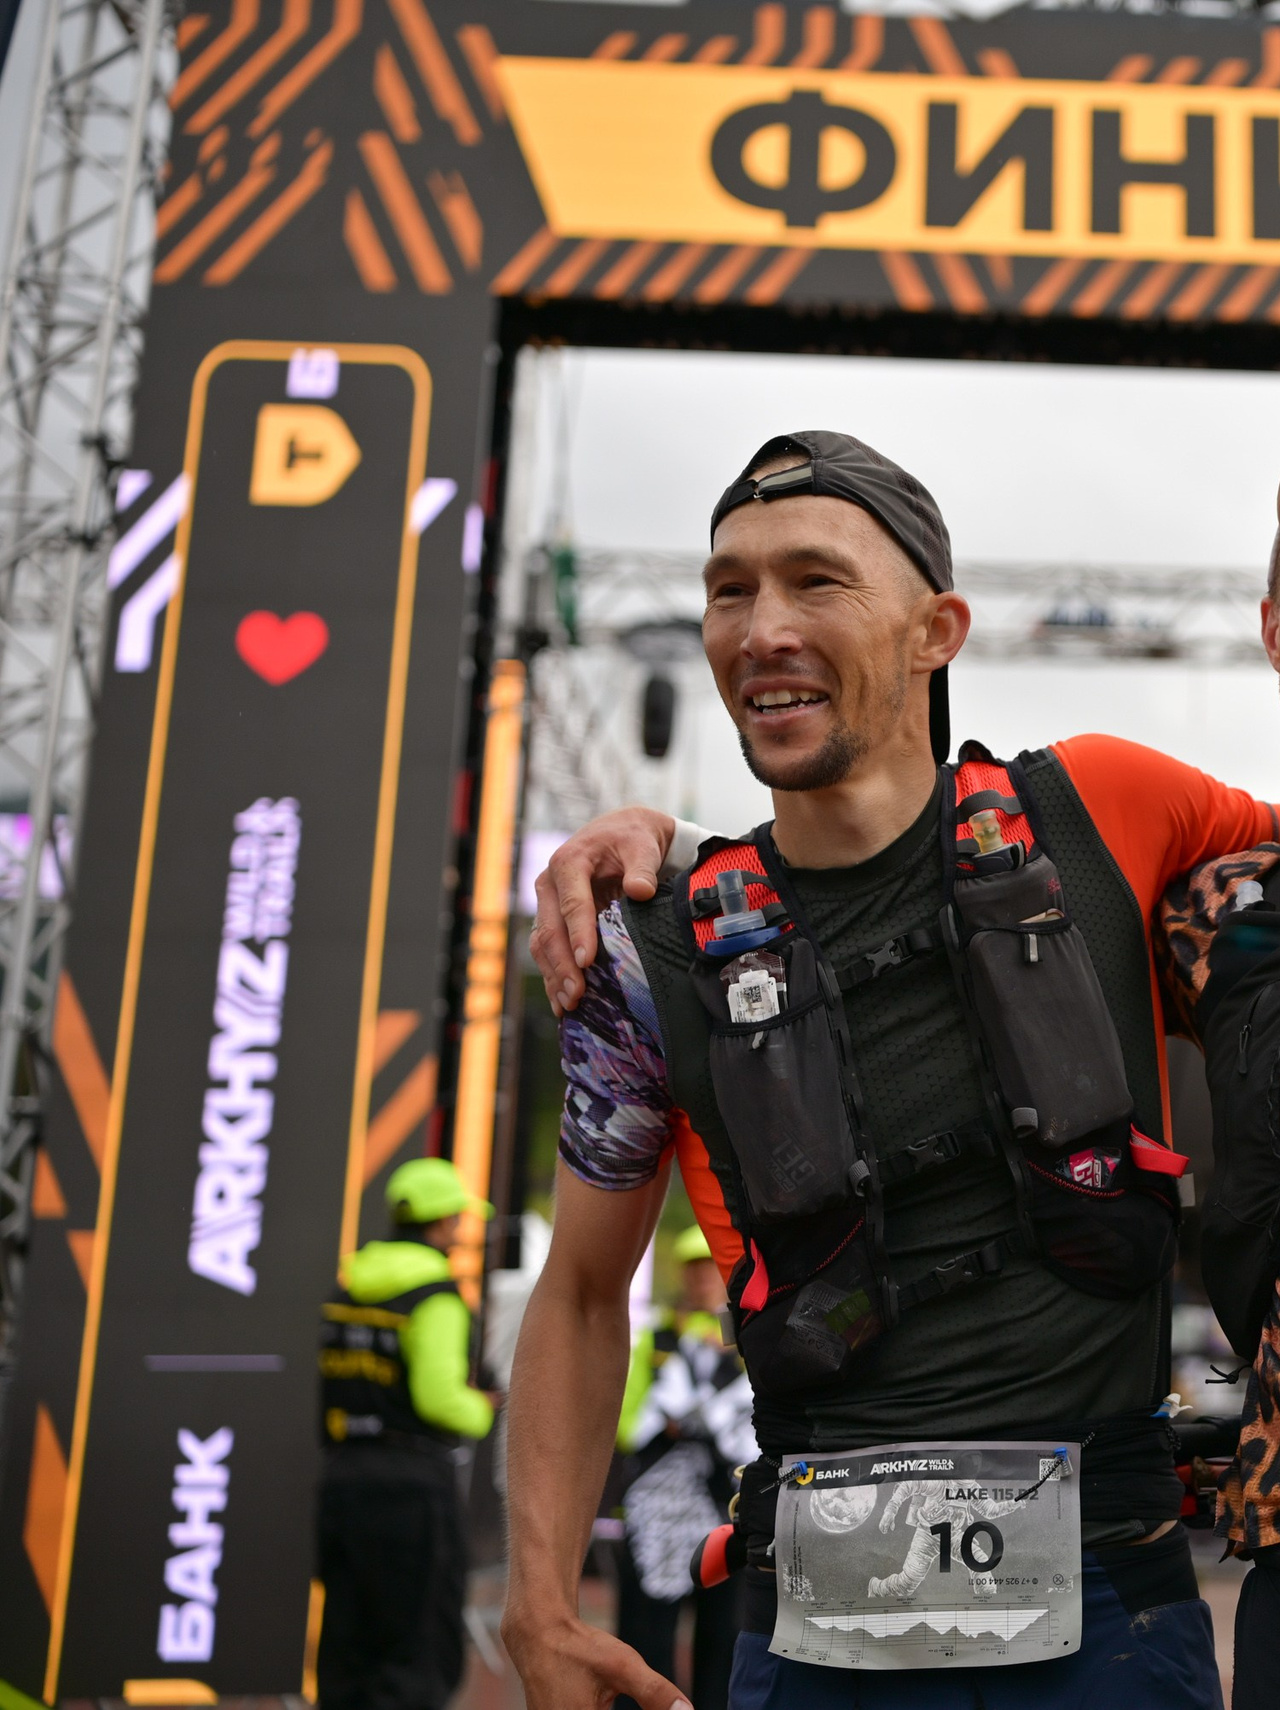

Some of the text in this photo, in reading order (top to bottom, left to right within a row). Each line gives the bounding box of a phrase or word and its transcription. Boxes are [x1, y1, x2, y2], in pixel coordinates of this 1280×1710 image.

[187, 936, 290, 1297] ARKHYZ
[869, 1459, 928, 1475] ARKHYZ
[815, 1468, 850, 1480] БАНК
[945, 1488, 988, 1500] LAKE
[992, 1488, 1014, 1500] 115
[156, 1425, 235, 1663] БАНК
[929, 1520, 1004, 1573] 10
[968, 1578, 975, 1586] 11
[1005, 1577, 1020, 1585] 925
[1021, 1577, 1030, 1585] +7
